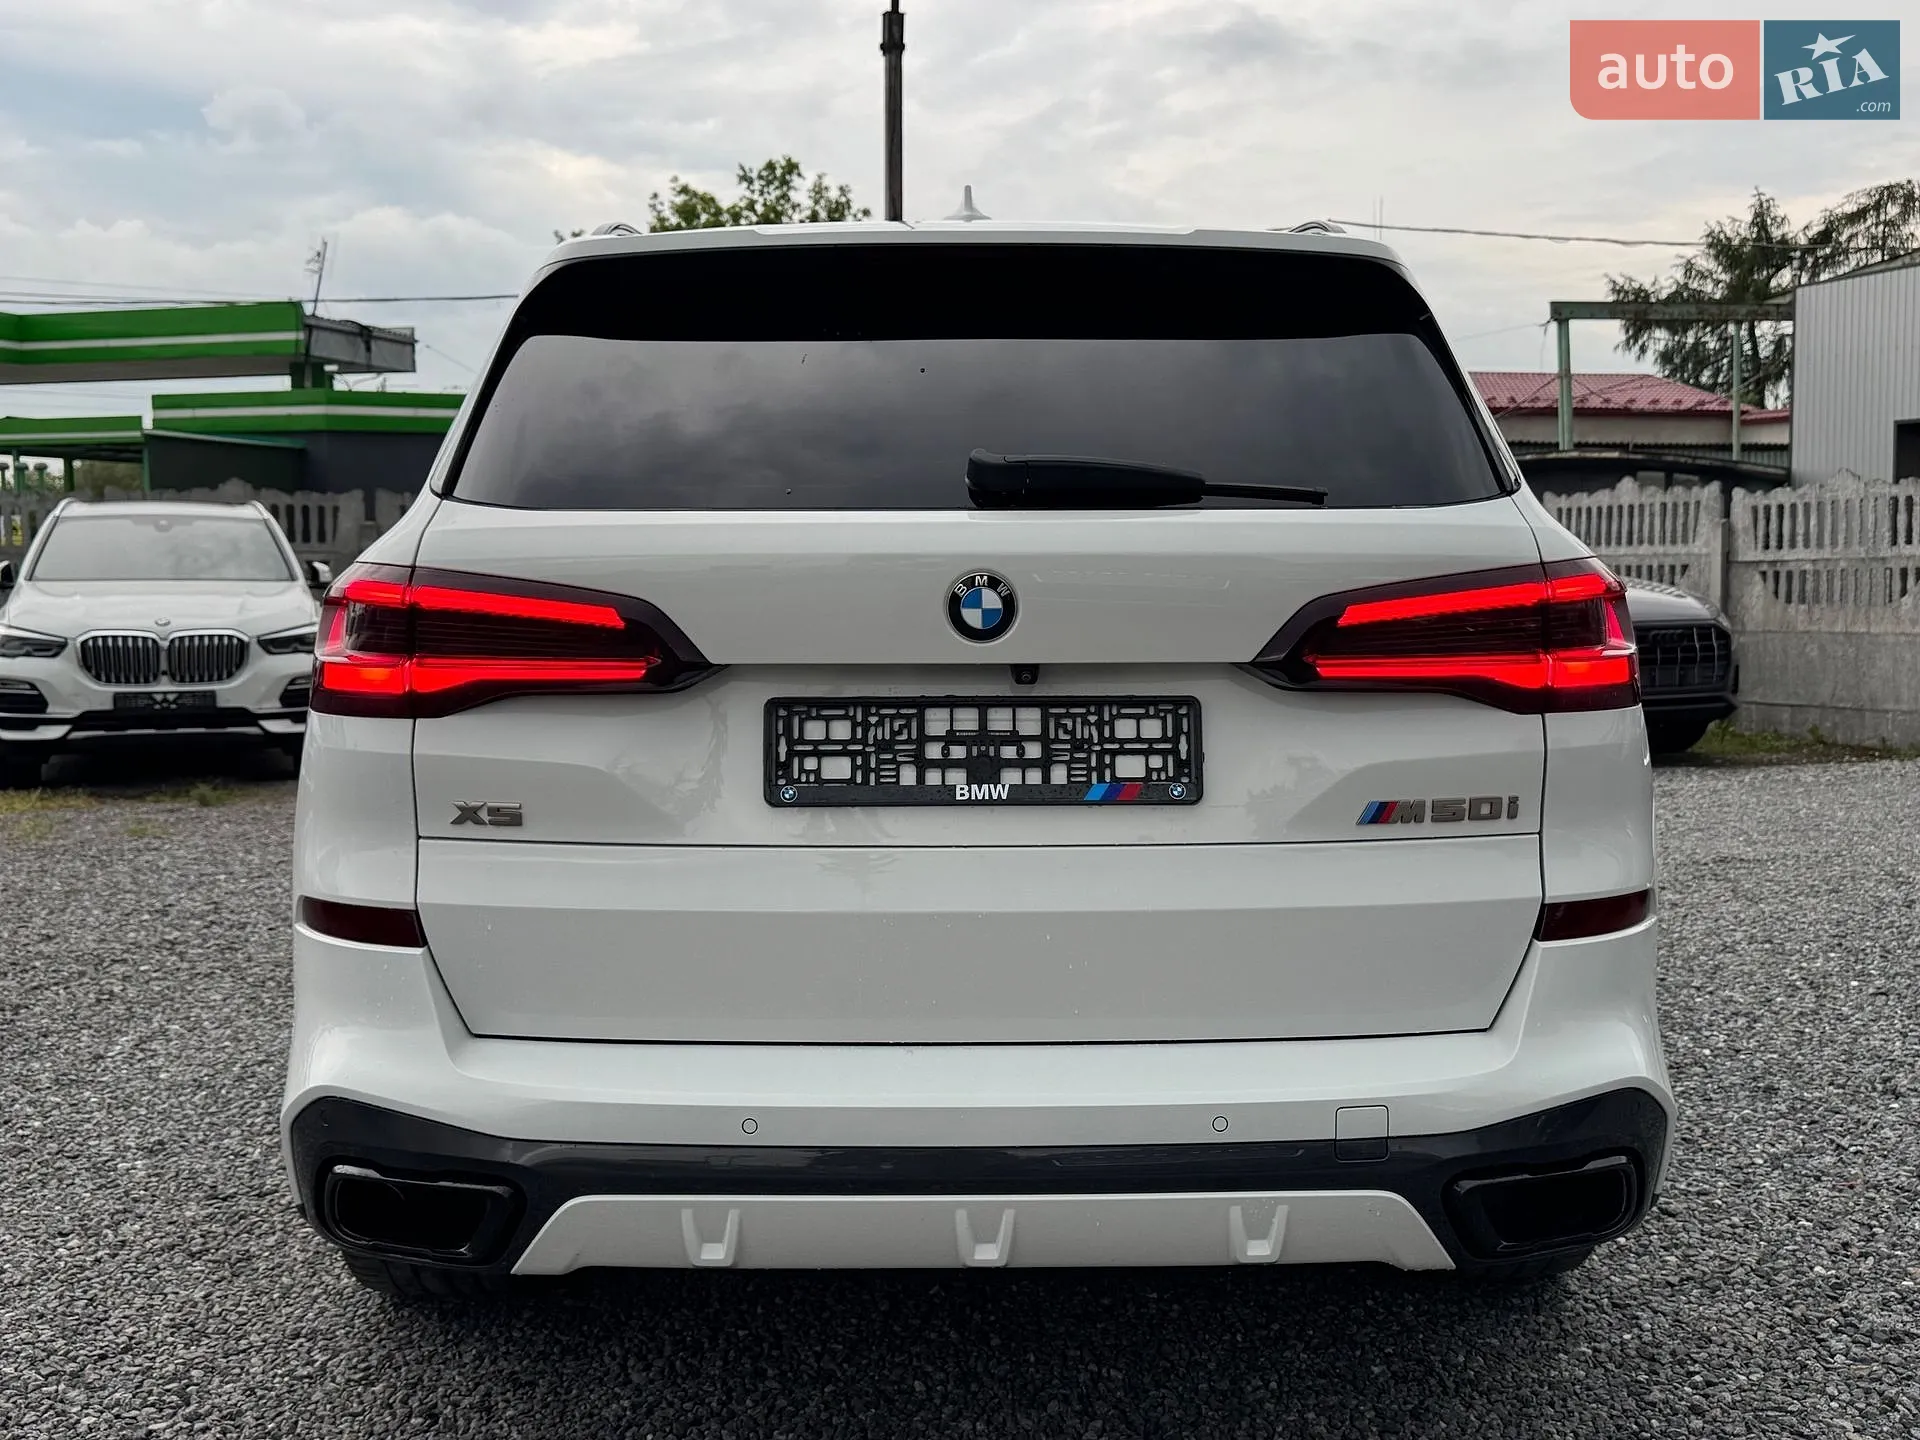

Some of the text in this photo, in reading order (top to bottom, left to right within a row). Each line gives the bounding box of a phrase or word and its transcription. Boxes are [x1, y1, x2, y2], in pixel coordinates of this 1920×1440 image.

[954, 575, 1011, 598] BMW
[955, 783, 1010, 800] BMW
[450, 801, 523, 827] X5
